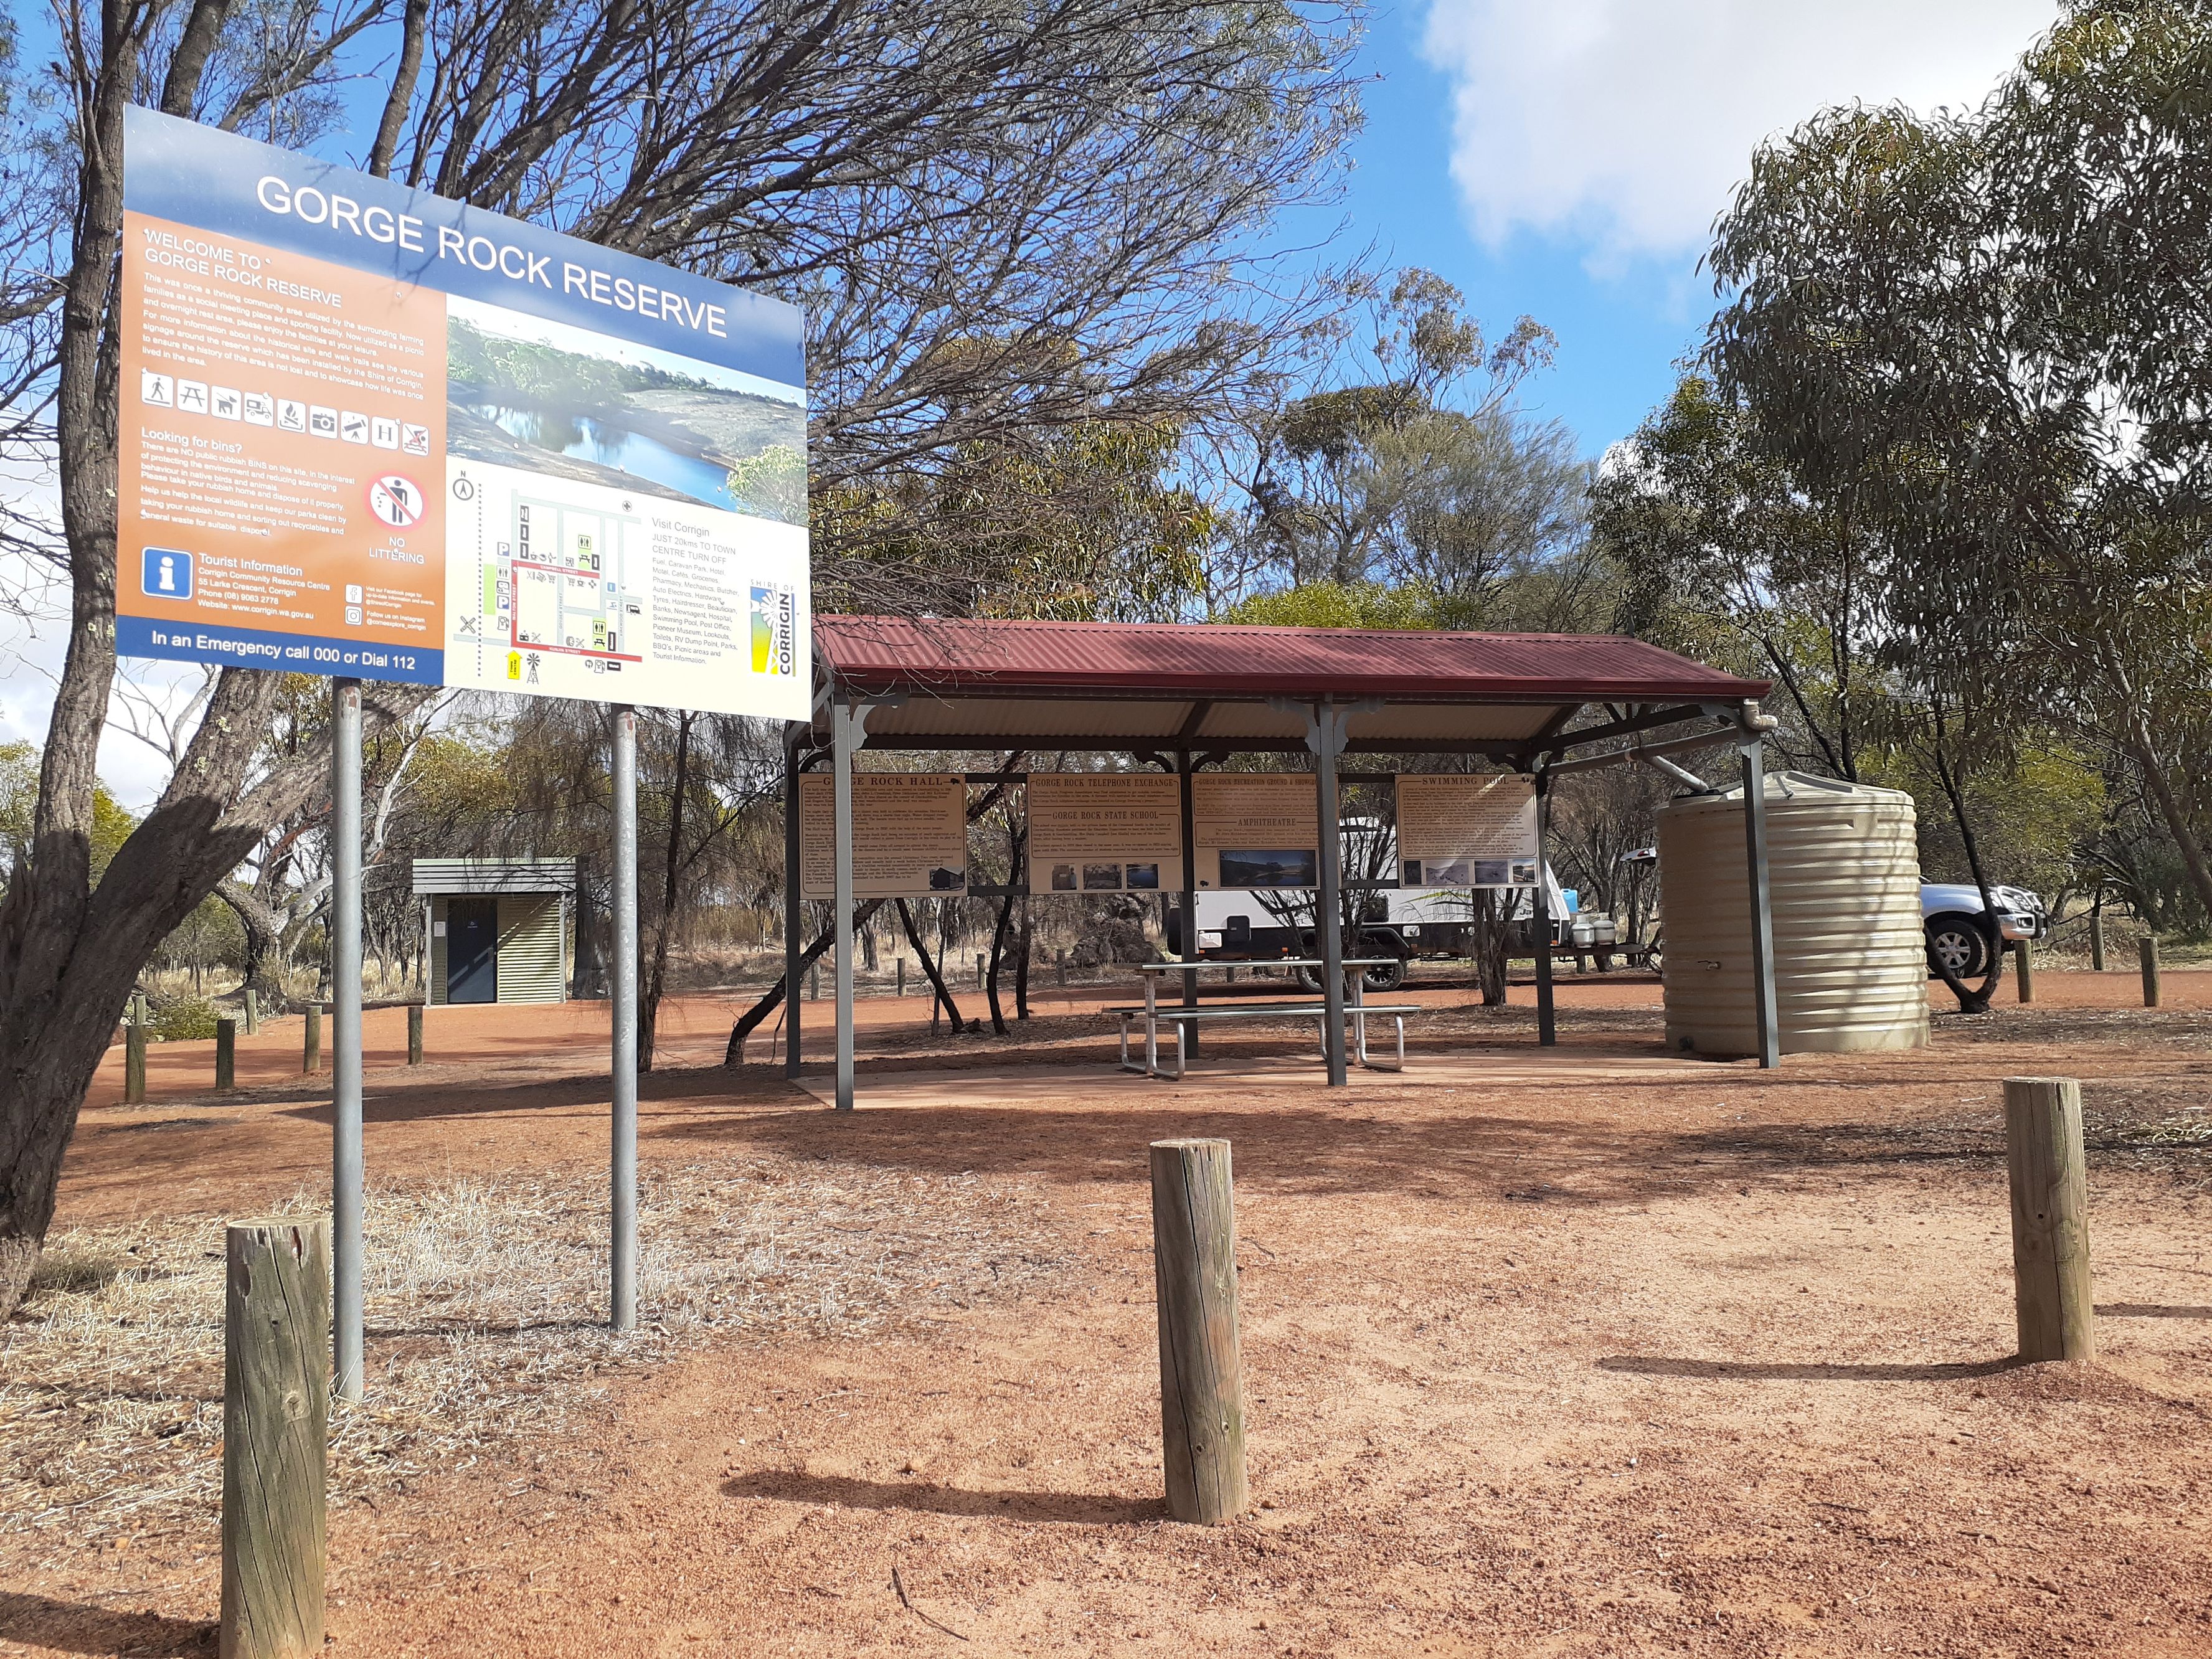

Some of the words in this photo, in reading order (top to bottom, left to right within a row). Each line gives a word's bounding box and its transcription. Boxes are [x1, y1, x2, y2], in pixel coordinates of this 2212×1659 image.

[144, 228, 234, 263] WELCOME
[238, 252, 260, 270] TO
[258, 176, 423, 252] GORGE
[440, 226, 552, 288] ROCK
[565, 263, 726, 338] RESERVE
[145, 248, 209, 276] GORGE
[214, 264, 262, 289] ROCK
[267, 277, 341, 308] RESERVE
[144, 272, 162, 283] This
[164, 278, 180, 288] was
[183, 283, 202, 293] once
[213, 289, 241, 303] thriving
[243, 297, 284, 313] community
[286, 308, 303, 316] area
[305, 312, 330, 323] utilized
[333, 317, 341, 327] by
[344, 320, 355, 329] the
[357, 324, 397, 340] surrounding
[400, 333, 423, 346] farming
[144, 284, 174, 298] families
[196, 298, 218, 308] social
[220, 303, 250, 317] meeting
[252, 311, 272, 321] place
[274, 316, 288, 324] and
[290, 319, 319, 333] sporting
[346, 331, 362, 341] Now
[363, 337, 387, 347] utilized
[405, 346, 424, 356] picnic
[143, 309, 158, 319] For
[160, 315, 181, 324] more
[184, 319, 226, 334] information
[229, 330, 250, 340] about
[253, 334, 265, 343] the
[268, 338, 300, 351] historical
[303, 346, 316, 354] site
[318, 350, 332, 358] and
[334, 354, 351, 362] walk
[352, 356, 370, 367] trails
[387, 364, 397, 372] the
[400, 369, 423, 378] various
[141, 427, 189, 447] Looking
[192, 435, 209, 448] for
[211, 439, 242, 454] bins?
[141, 441, 164, 451] There
[181, 447, 194, 456] NO
[196, 451, 218, 461] public
[219, 456, 246, 466] rubbish
[248, 459, 267, 470] BINS
[280, 465, 292, 473] this
[318, 471, 329, 480] the
[330, 474, 355, 484] interest
[141, 462, 179, 475] behaviour
[190, 471, 212, 481] native
[214, 475, 232, 484] birds
[150, 455, 189, 468] protecting
[190, 460, 202, 468] the
[204, 464, 250, 477] environment
[267, 474, 296, 486] reducing
[298, 480, 337, 493] scavenging
[652, 518, 671, 530] Visit
[674, 522, 709, 537] Corrigin
[389, 537, 405, 547] NO
[652, 534, 673, 543] JUST
[674, 537, 698, 548] 20kms
[700, 542, 711, 551] TO
[713, 544, 735, 555] TOWN
[199, 552, 237, 568] Tourist
[241, 558, 303, 576] Information
[369, 547, 424, 564] LITTERING
[653, 545, 685, 558] CENTRE
[688, 551, 709, 562] TURN
[711, 555, 726, 564] OFF
[198, 577, 208, 585] 55
[210, 579, 230, 588] Larke
[268, 587, 296, 597] Corrigin
[199, 567, 228, 578] Corrigin
[229, 571, 270, 584] Community
[272, 576, 305, 587] Resource
[307, 581, 330, 590] Centre
[751, 579, 777, 589] SHIRE
[198, 588, 222, 598] Phone
[224, 592, 239, 601] (08)
[241, 593, 259, 602] 9063
[260, 596, 278, 605] 2778
[653, 614, 683, 625] Swimming
[779, 593, 790, 675] CORRIGIN
[153, 631, 166, 645] In
[171, 636, 191, 647] an
[197, 635, 281, 659] Emergency
[286, 646, 309, 659] call
[314, 647, 339, 662] 000
[344, 653, 358, 664] or
[362, 652, 387, 667] Dial
[393, 656, 415, 669] 112
[653, 651, 672, 660] Tourist
[823, 777, 864, 785] GGE
[871, 777, 903, 785] ROCK
[910, 777, 943, 785] HALL
[1135, 778, 1173, 787] EXCHANGE
